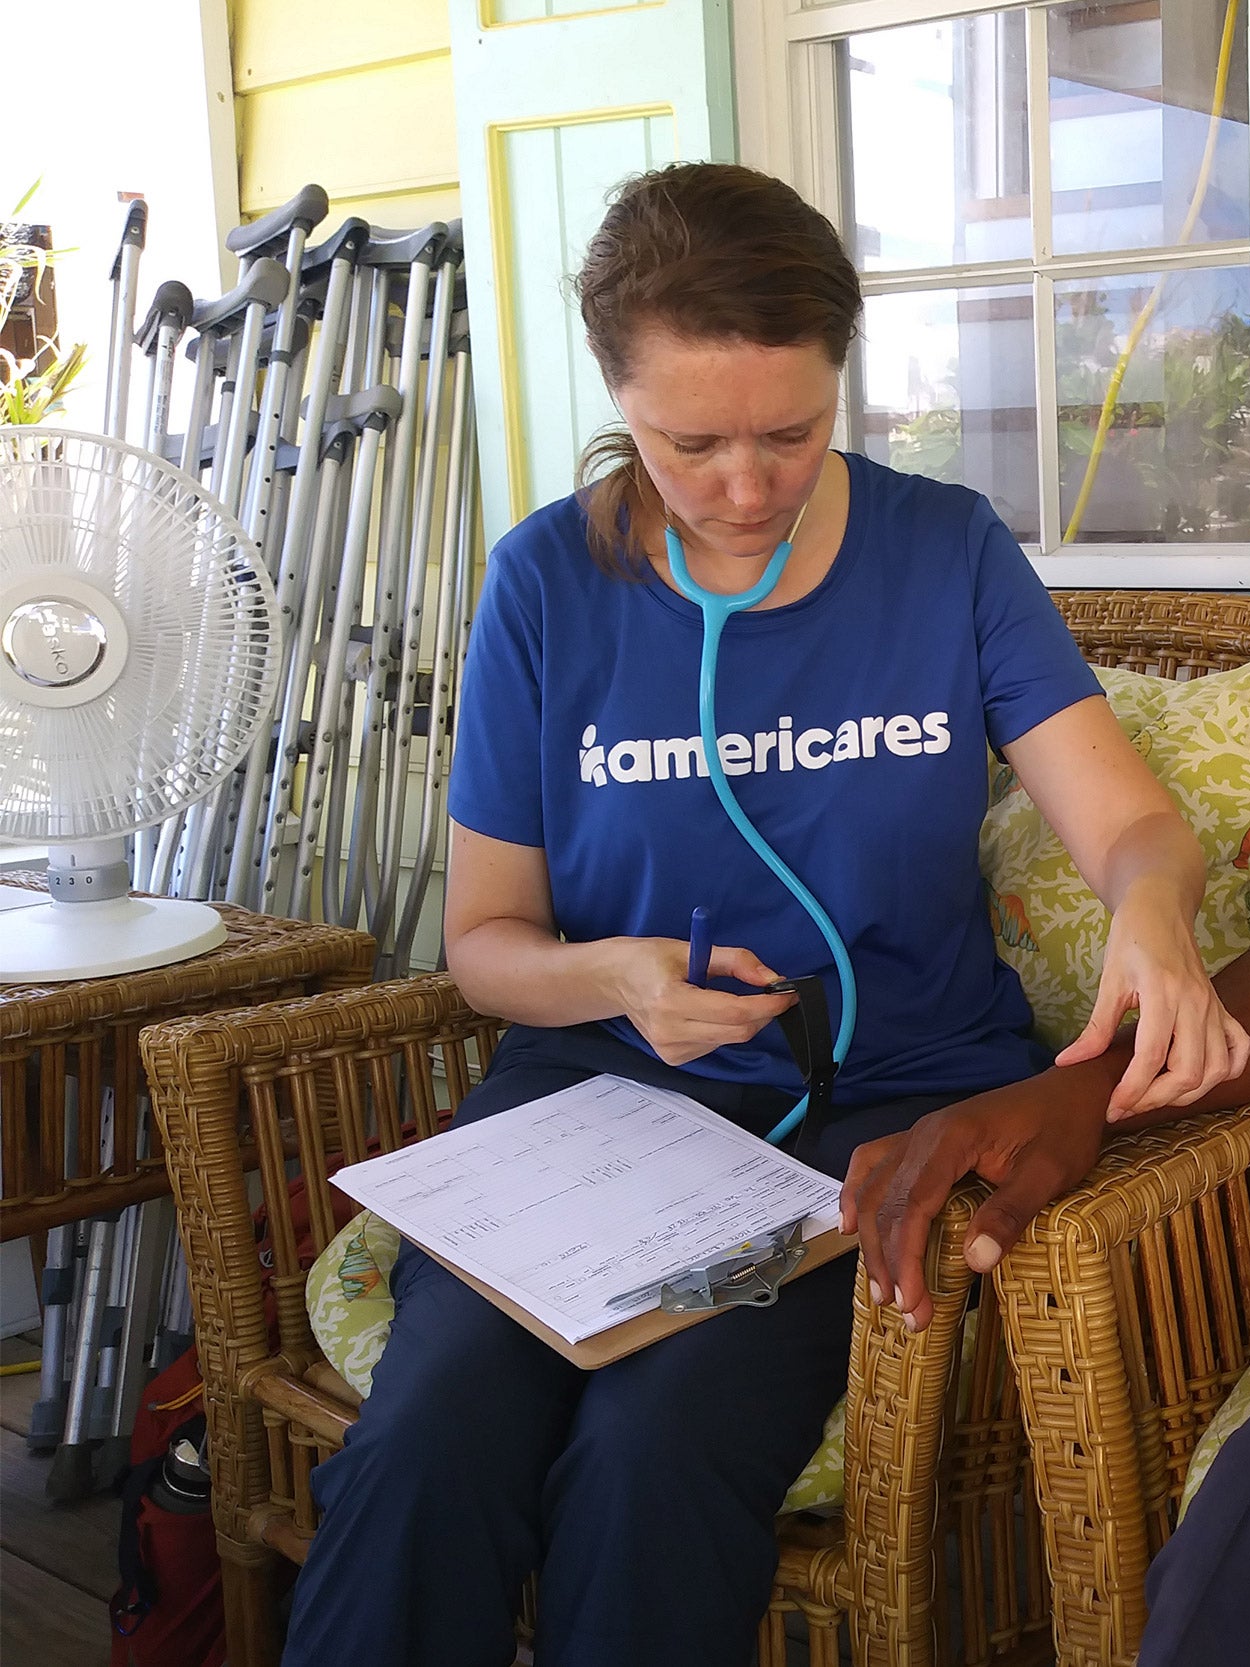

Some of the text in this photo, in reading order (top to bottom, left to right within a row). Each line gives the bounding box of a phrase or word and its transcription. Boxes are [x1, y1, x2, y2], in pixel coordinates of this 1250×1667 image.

[607, 710, 951, 783] americares
[55, 877, 61, 886] 2
[69, 877, 75, 886] 3
